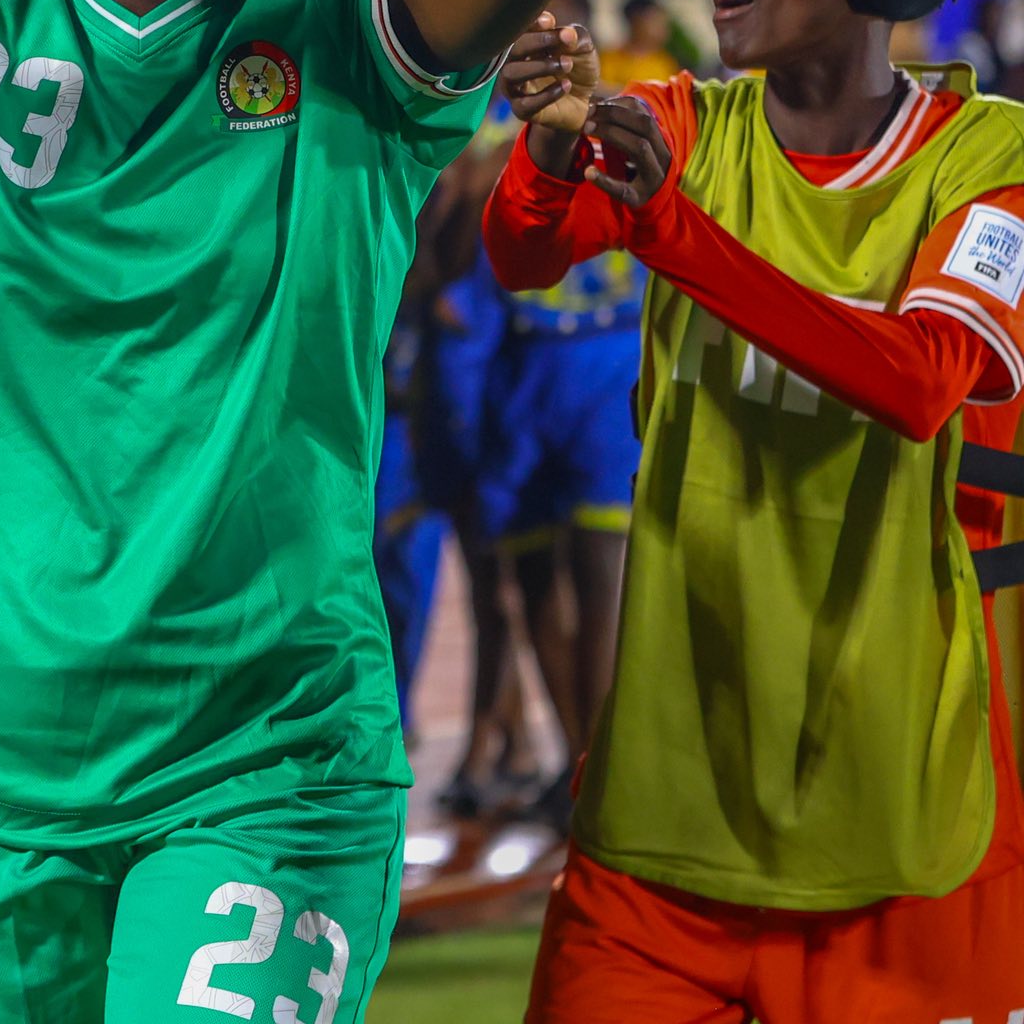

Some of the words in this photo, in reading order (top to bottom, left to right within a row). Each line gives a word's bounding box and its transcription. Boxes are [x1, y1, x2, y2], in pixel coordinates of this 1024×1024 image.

[219, 58, 236, 113] FOOTBALL
[280, 58, 297, 96] KENYA
[229, 113, 297, 131] FEDERATION
[976, 232, 1020, 263] UNITES
[982, 221, 1023, 250] FOOTBALL
[176, 881, 351, 1024] 23
